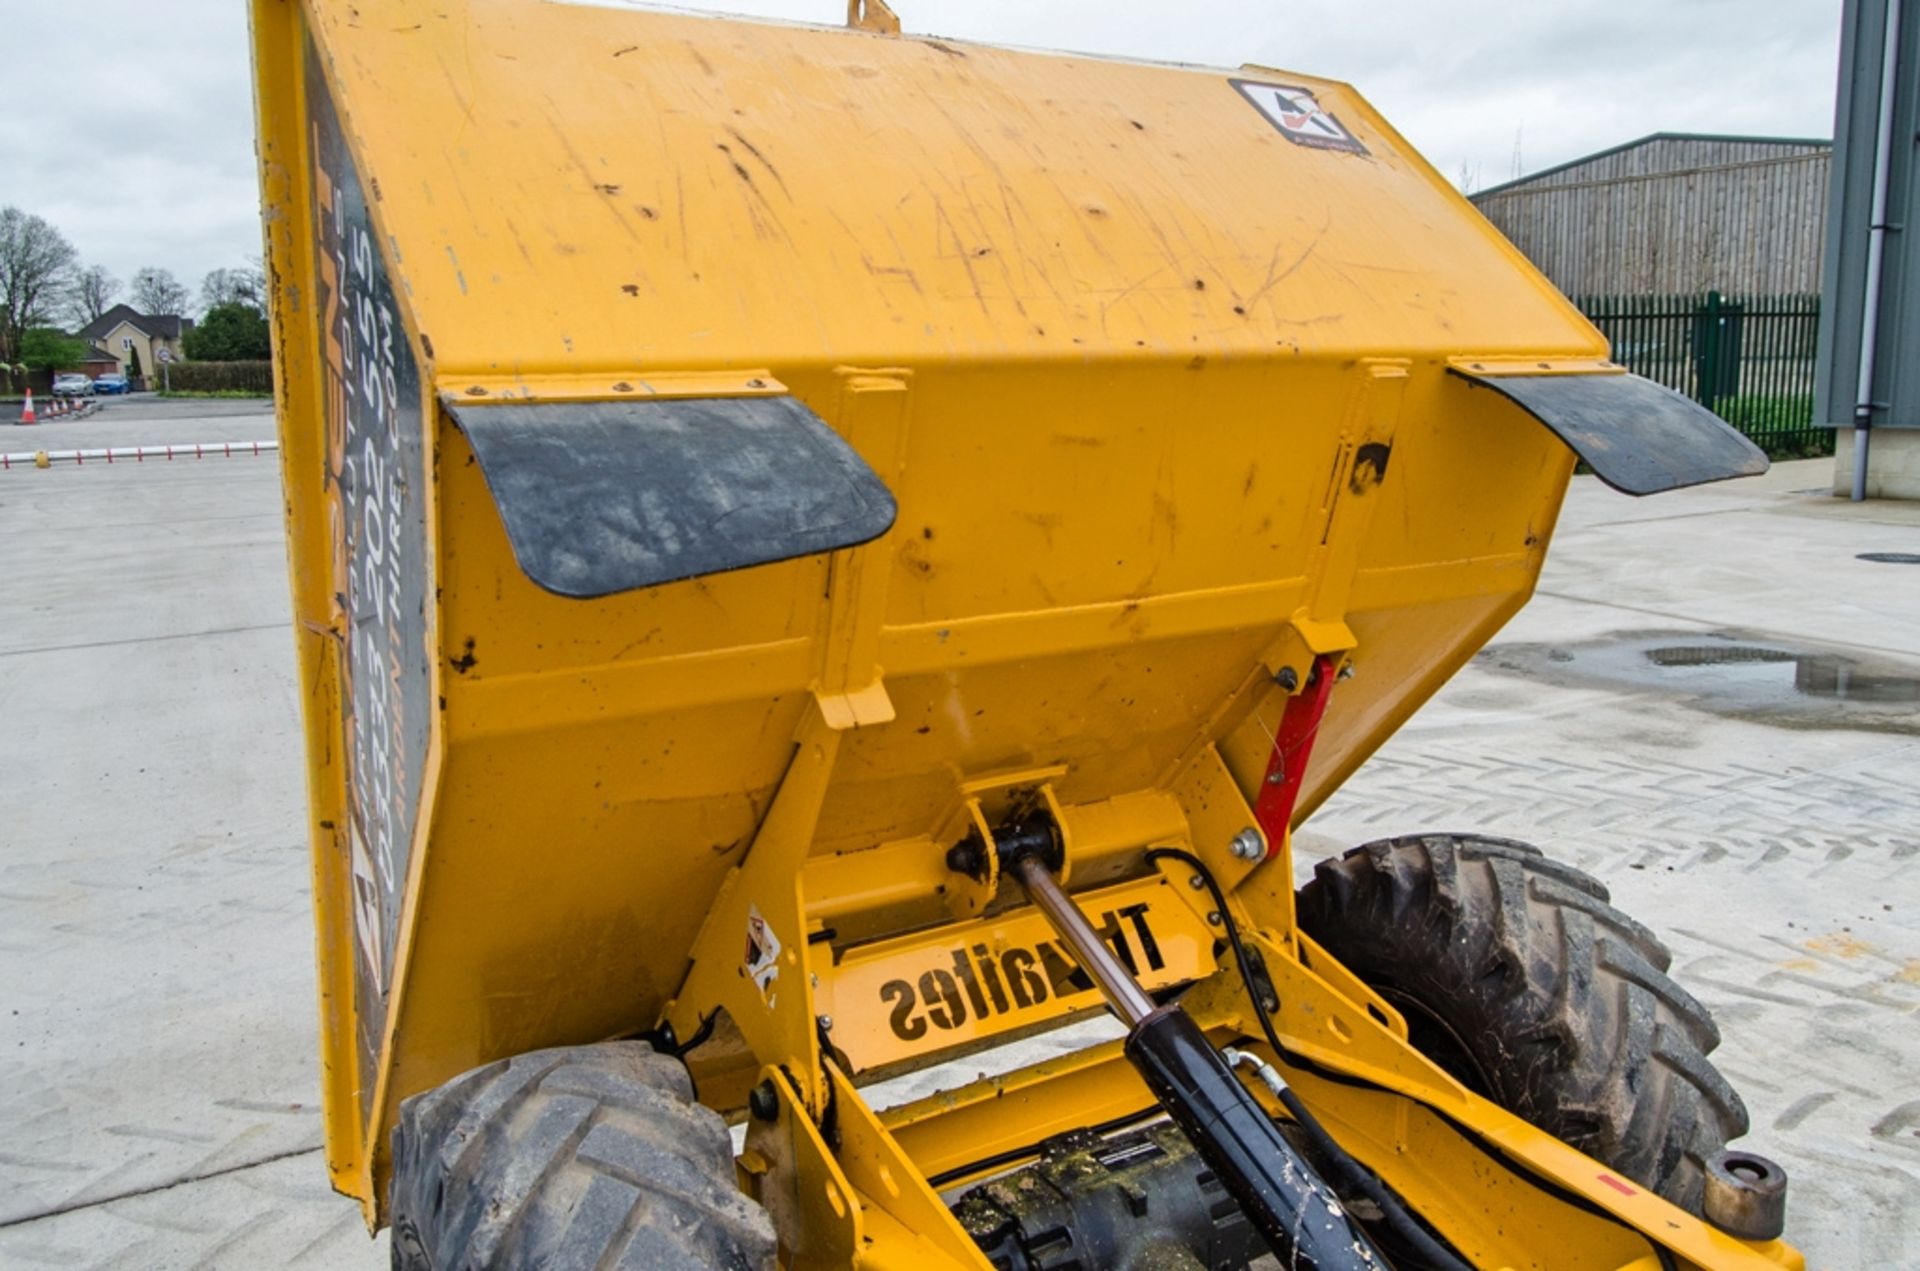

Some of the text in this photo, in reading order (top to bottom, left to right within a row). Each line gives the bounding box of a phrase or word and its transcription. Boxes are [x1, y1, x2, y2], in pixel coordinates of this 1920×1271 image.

[353, 226, 394, 894] 03333 202 555
